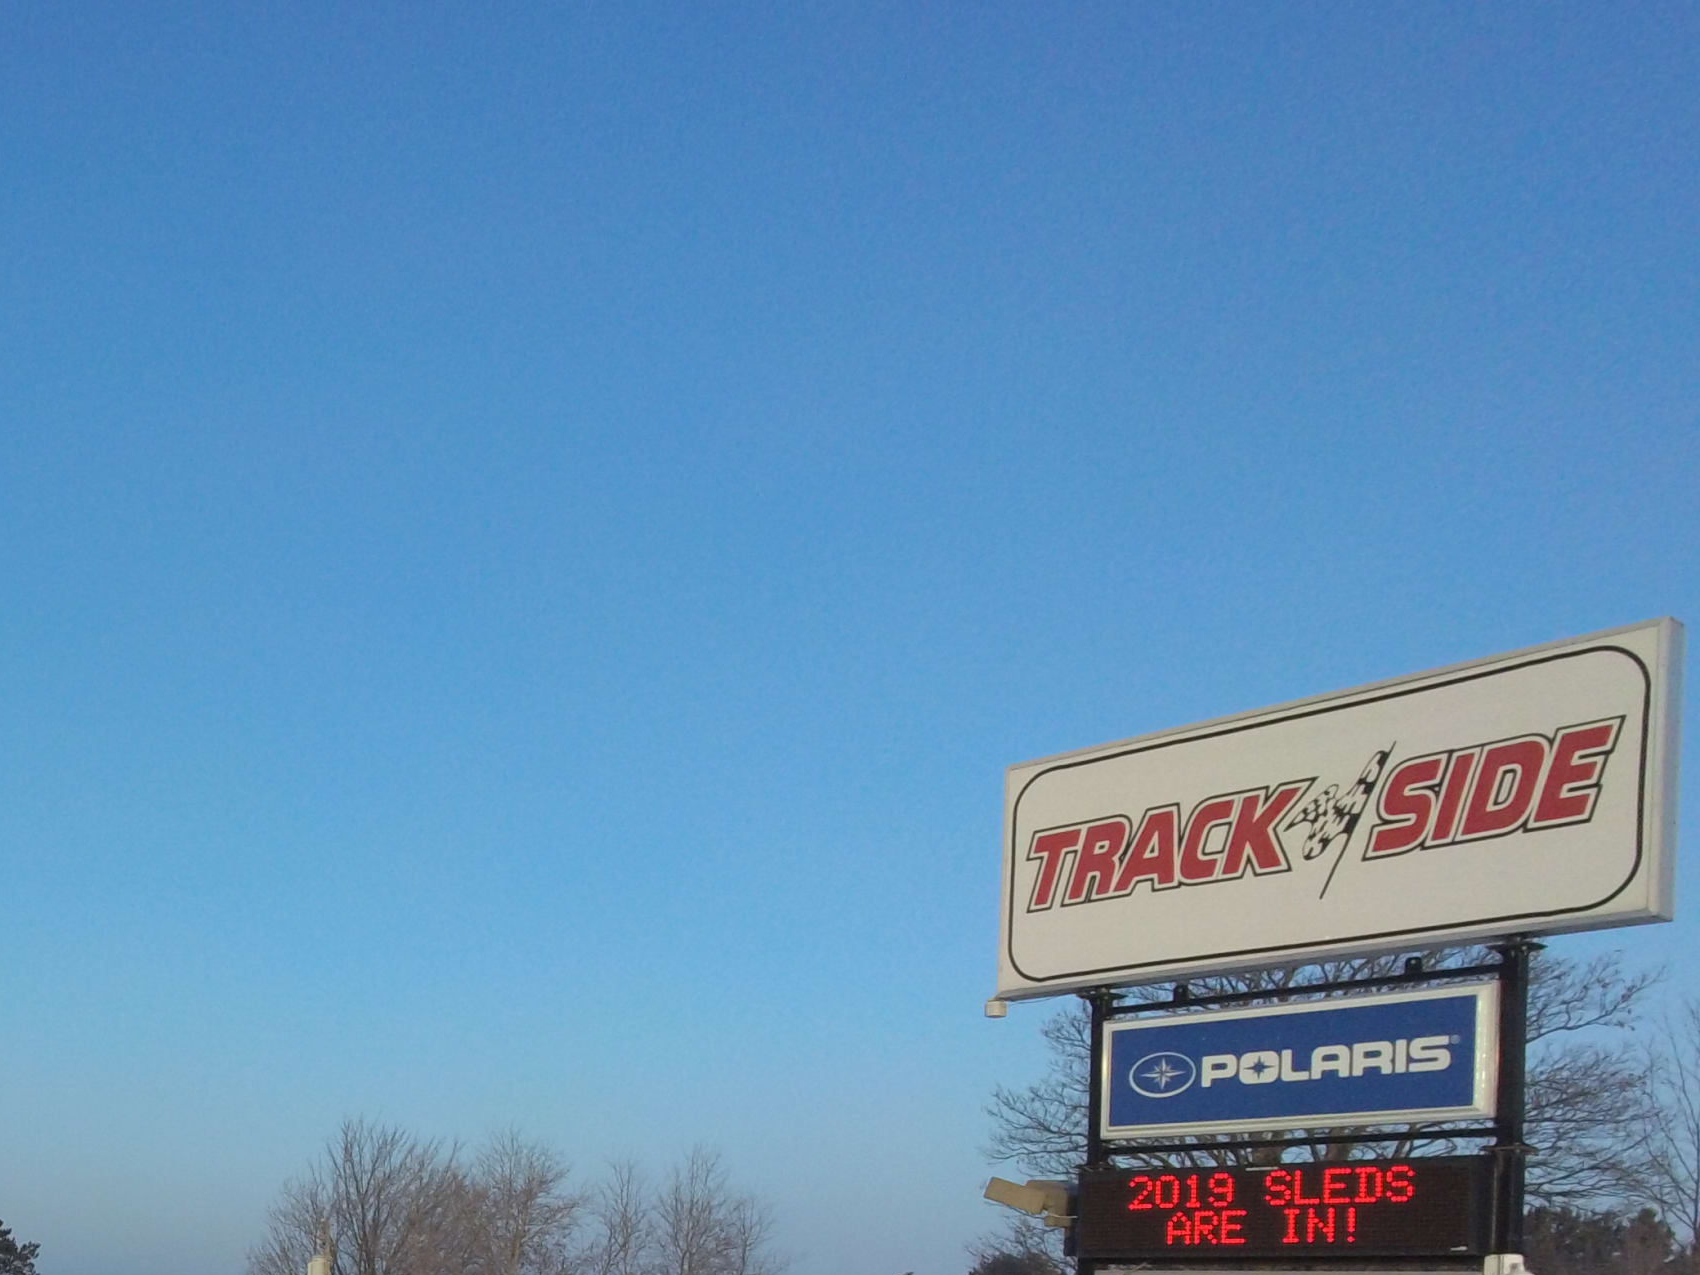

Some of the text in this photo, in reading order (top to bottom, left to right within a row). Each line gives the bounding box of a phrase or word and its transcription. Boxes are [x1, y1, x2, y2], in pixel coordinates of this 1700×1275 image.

[1027, 714, 1627, 913] TRACK SIDE
[1201, 1035, 1452, 1087] POLARIS
[1128, 1165, 1416, 1211] 2019 SLEDS
[1166, 1207, 1356, 1245] ARE IN!
